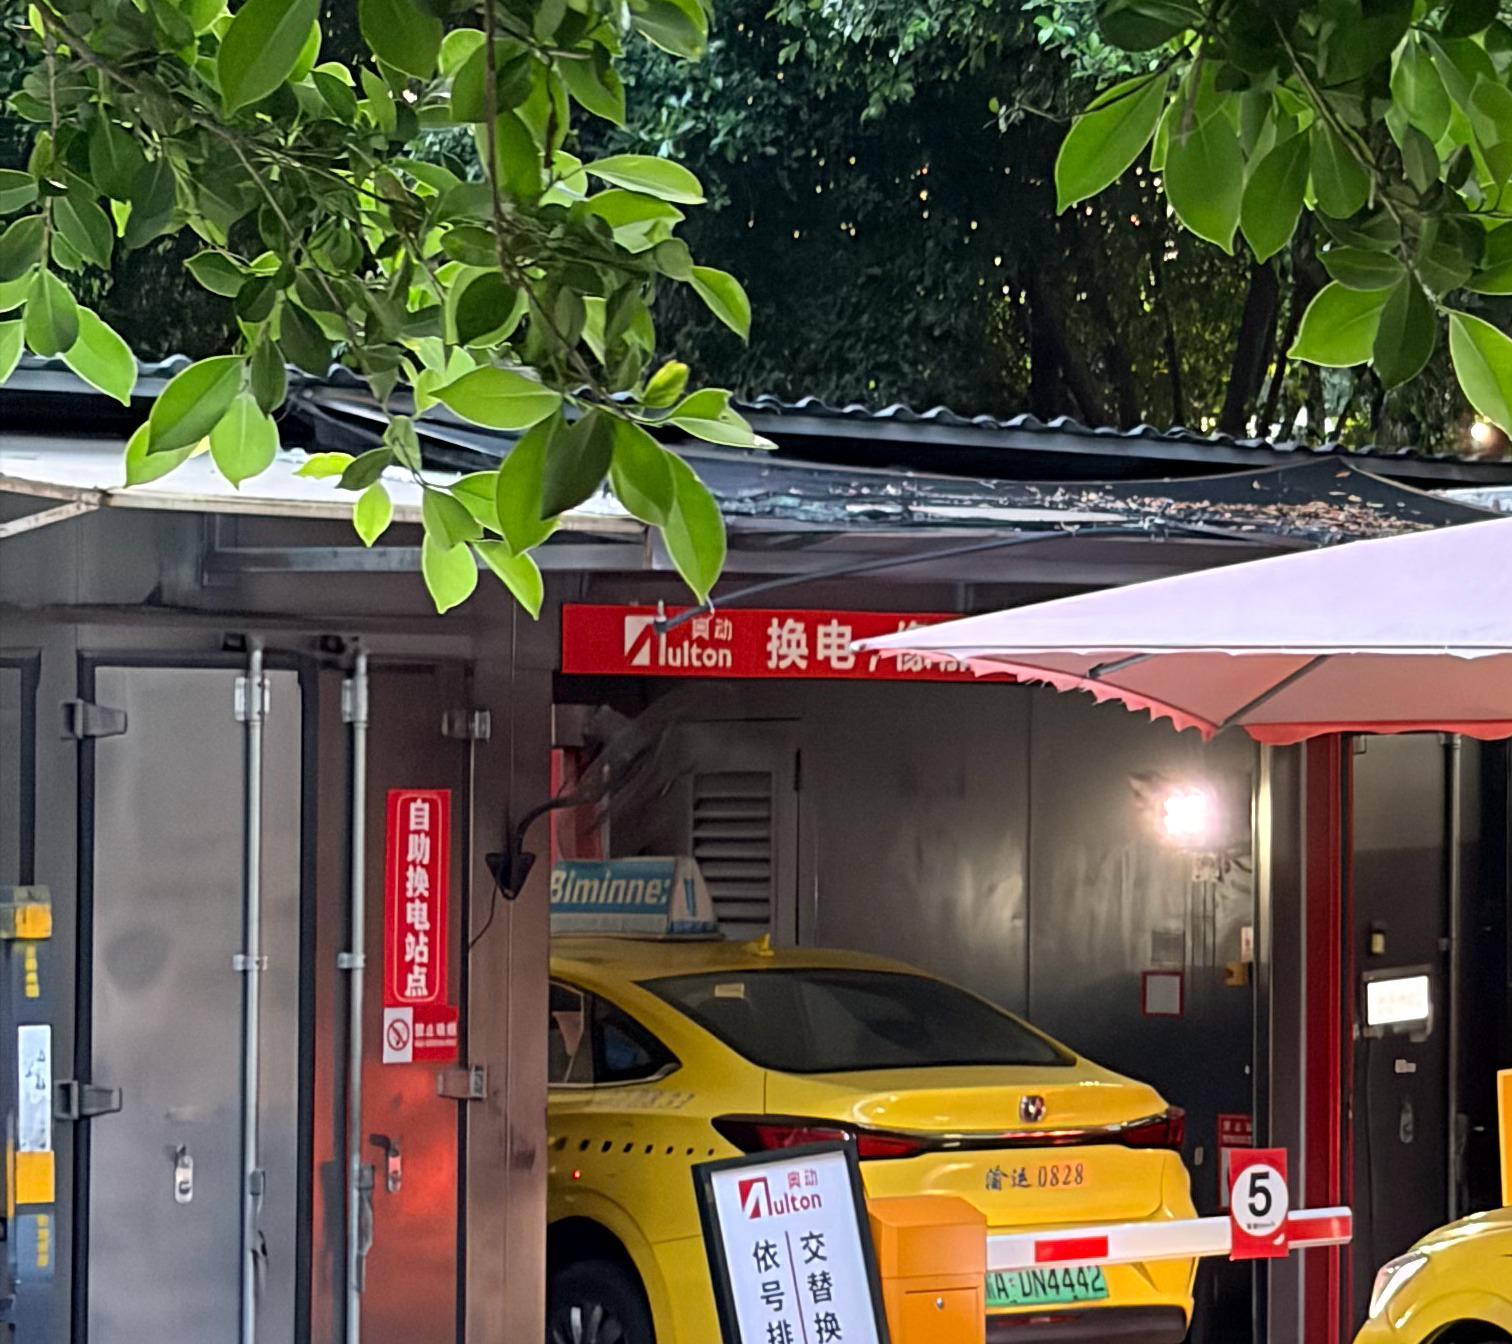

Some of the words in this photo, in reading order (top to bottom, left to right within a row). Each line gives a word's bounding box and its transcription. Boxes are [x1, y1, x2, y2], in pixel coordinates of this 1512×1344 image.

[404, 798, 431, 997] 自助换电站点
[738, 1176, 822, 1220] Aulton
[1037, 1163, 1084, 1188] 0828
[1248, 1171, 1272, 1217] 5
